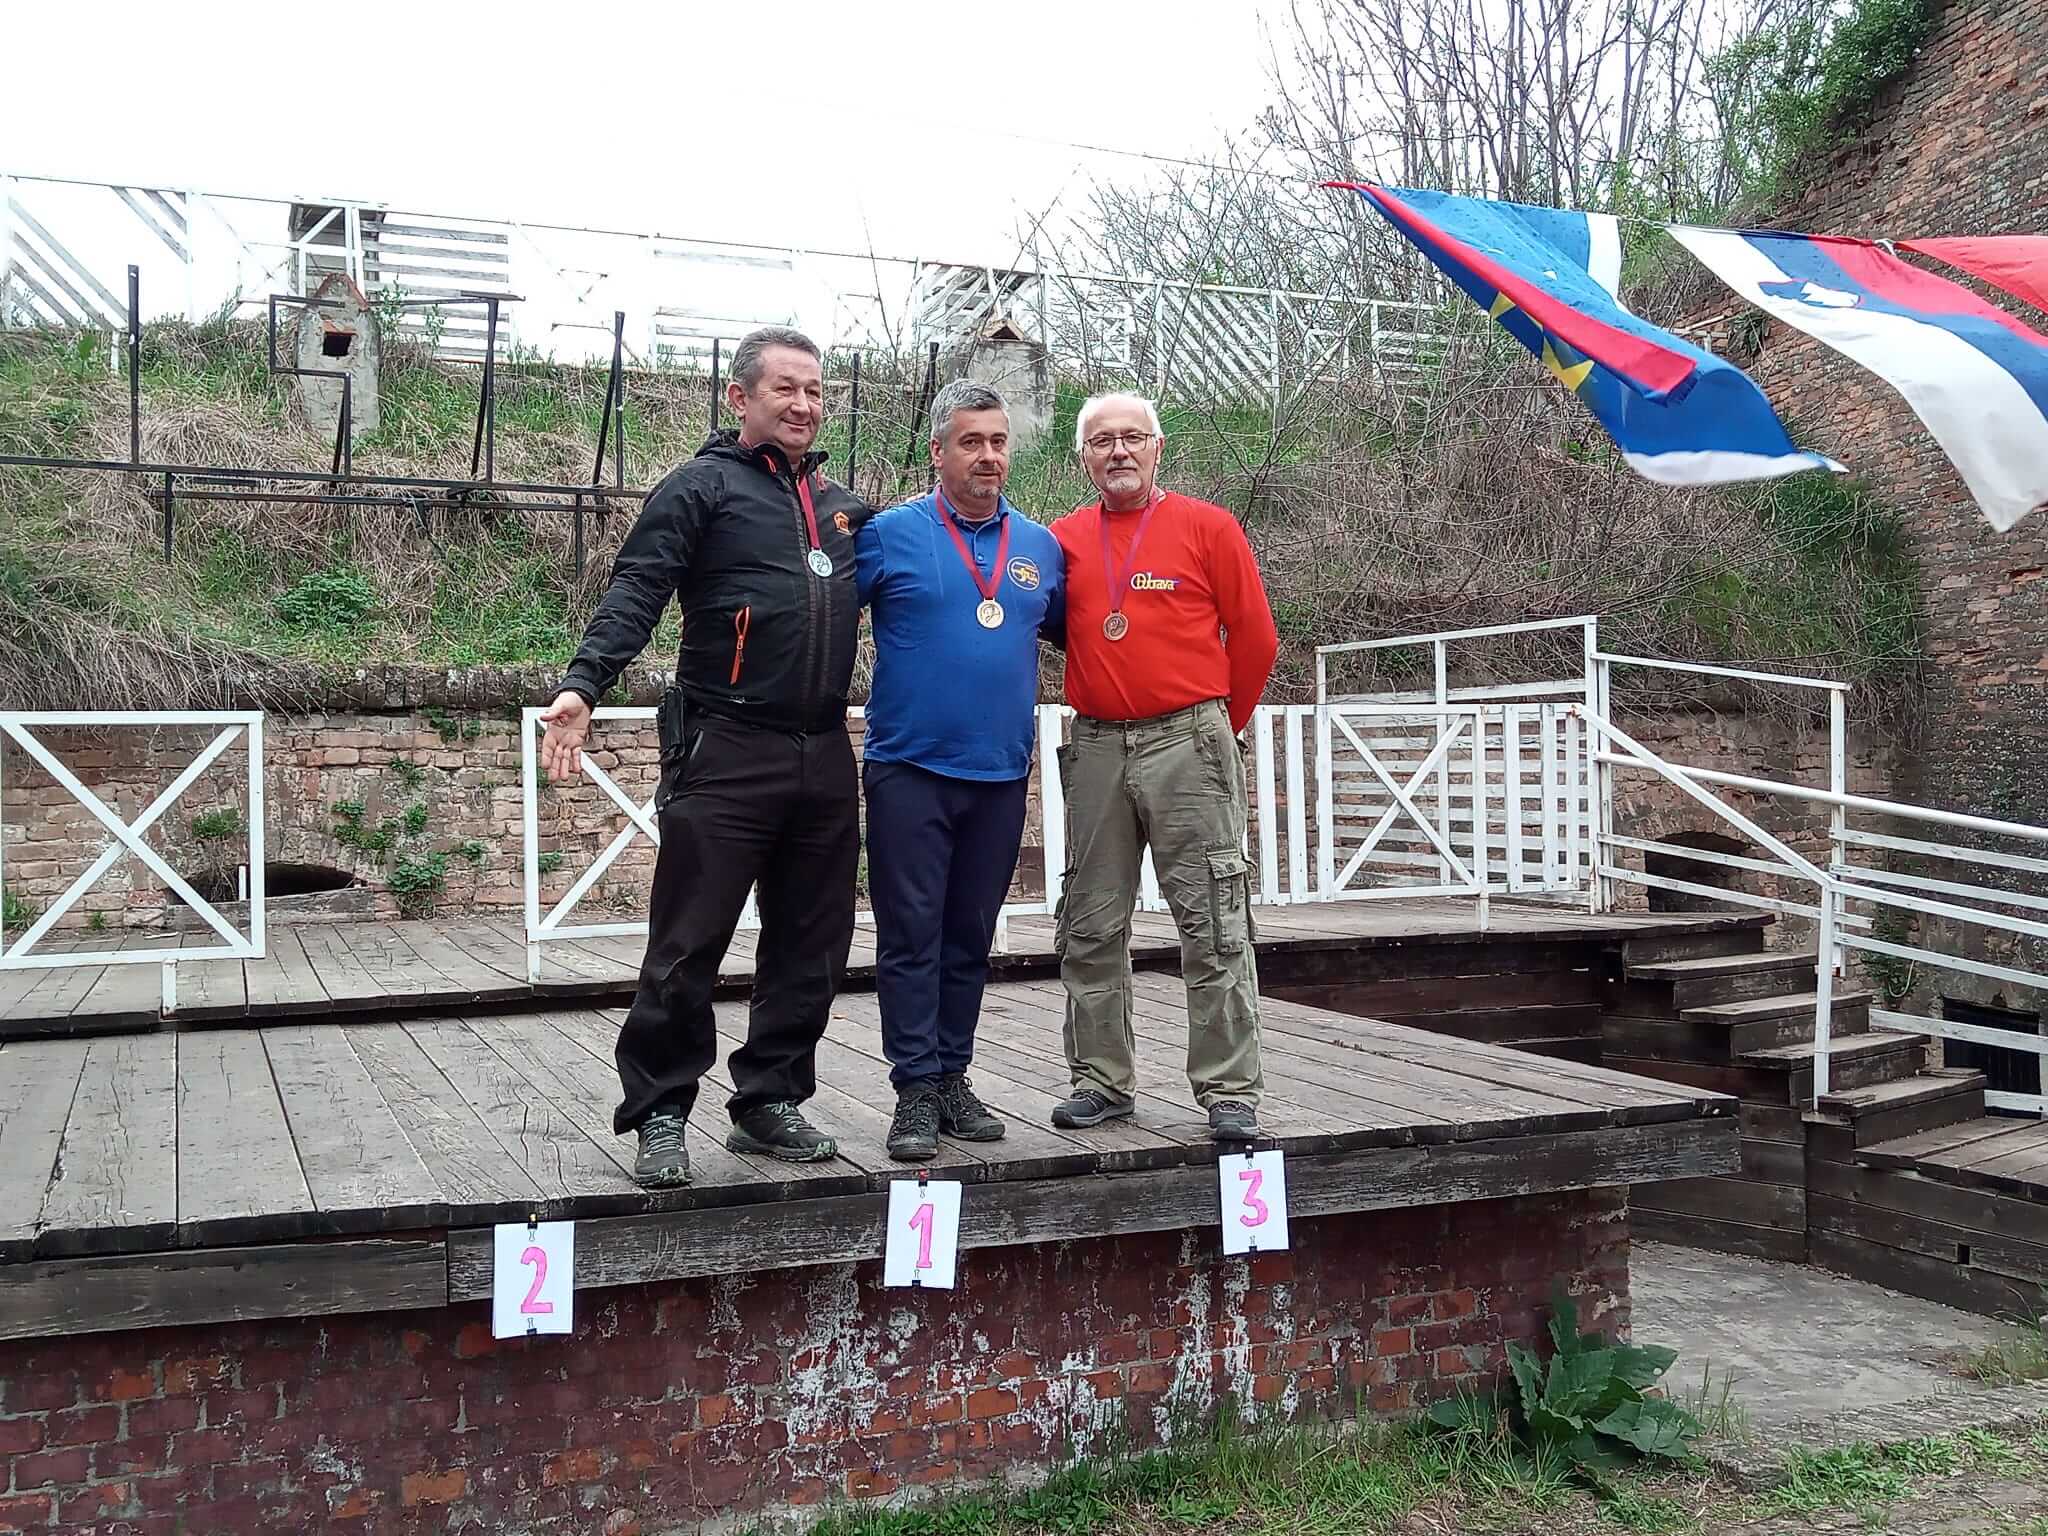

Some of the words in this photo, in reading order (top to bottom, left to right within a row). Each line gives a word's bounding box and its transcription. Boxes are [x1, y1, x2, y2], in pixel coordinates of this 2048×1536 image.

[1240, 1169, 1269, 1227] 3
[909, 1204, 935, 1268] 1
[520, 1246, 553, 1313] 2
